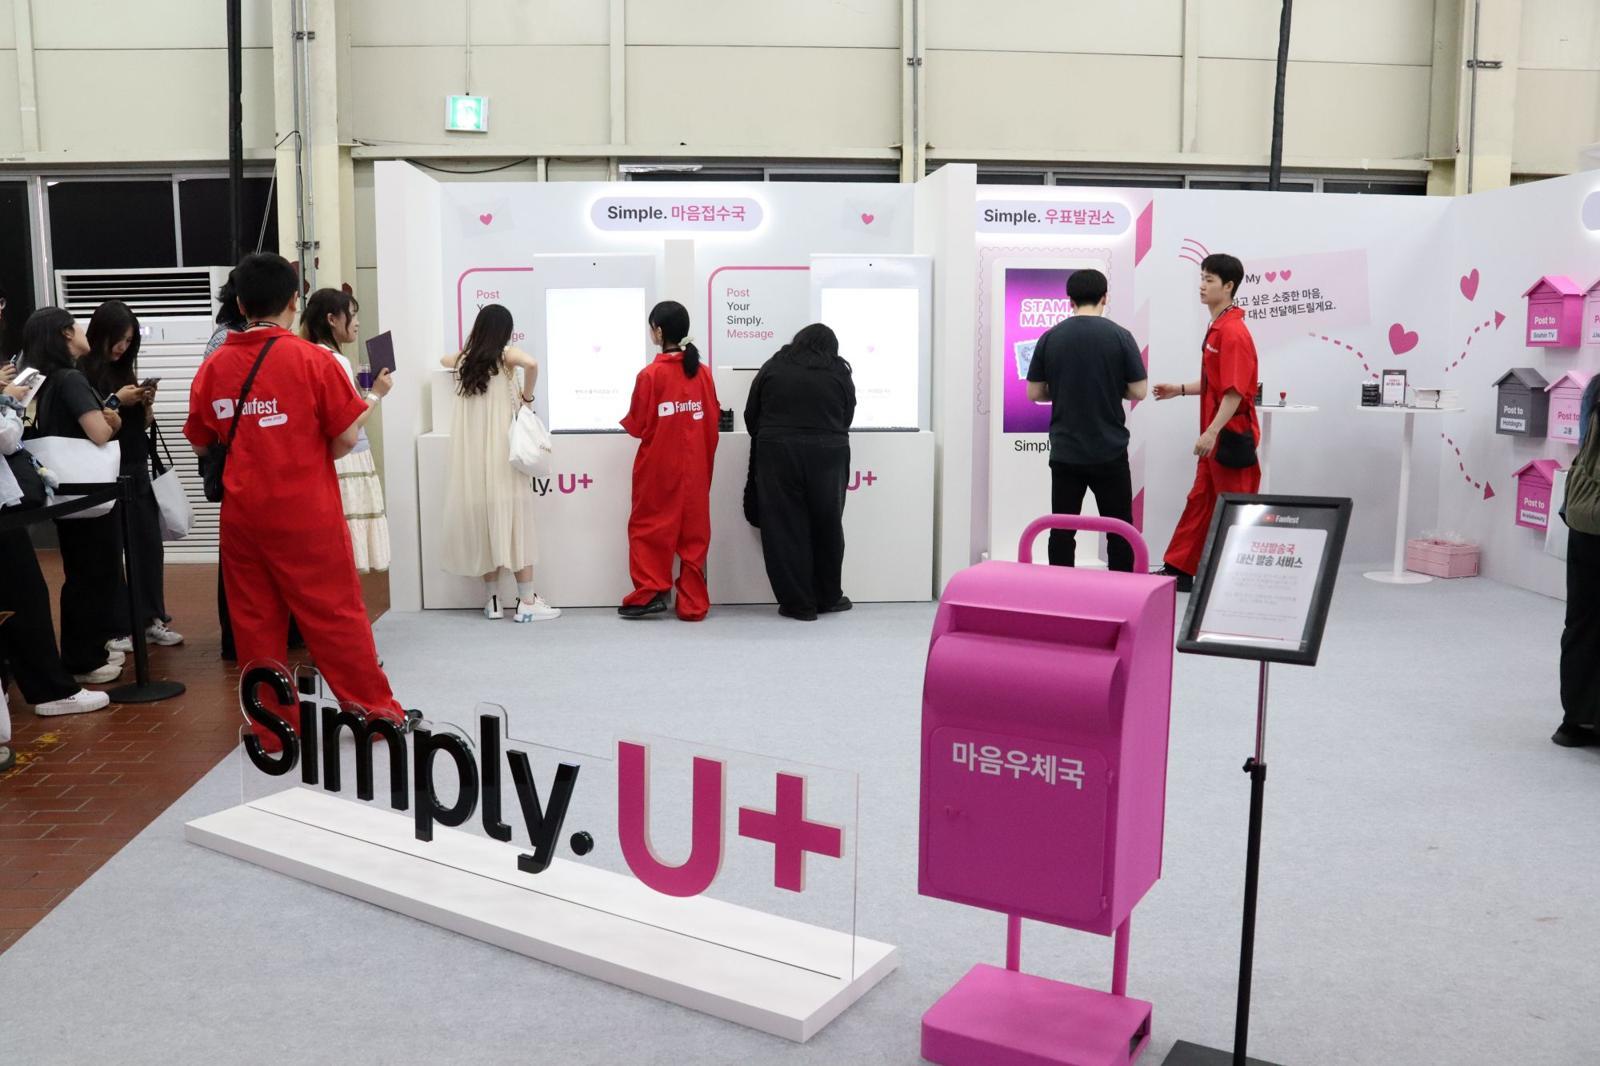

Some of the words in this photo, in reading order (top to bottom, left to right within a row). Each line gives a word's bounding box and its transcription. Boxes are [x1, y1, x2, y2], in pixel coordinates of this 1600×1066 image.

[607, 205, 668, 222] Simple.
[671, 205, 746, 221] 마음접수국
[984, 209, 1041, 226] Simple.
[1045, 208, 1115, 225] 우표발권소
[1245, 274, 1261, 284] My
[476, 289, 500, 299] Post
[726, 287, 750, 297] Post
[1251, 294, 1270, 306] 싶은
[1272, 290, 1300, 303] 소중한
[1301, 287, 1324, 300] 마음,
[726, 301, 751, 311] Your
[1248, 308, 1267, 320] 대신
[1269, 300, 1337, 318] 전달해드릴게요.
[726, 315, 765, 327] Simply.
[1022, 313, 1070, 325] MATC
[1534, 315, 1548, 325] Post
[1548, 316, 1556, 325] to
[726, 329, 774, 341] Message
[1503, 405, 1517, 414] Post
[1517, 406, 1524, 415] to
[1557, 411, 1572, 420] Post
[1014, 439, 1050, 454] Simpl
[558, 473, 593, 494] U+
[1524, 497, 1538, 508] Post
[1275, 514, 1300, 524] Fanfest
[1275, 555, 1304, 568] 서비스
[952, 742, 1086, 790] 마음우체국
[243, 666, 595, 874] Simply.
[618, 740, 845, 898] U+
